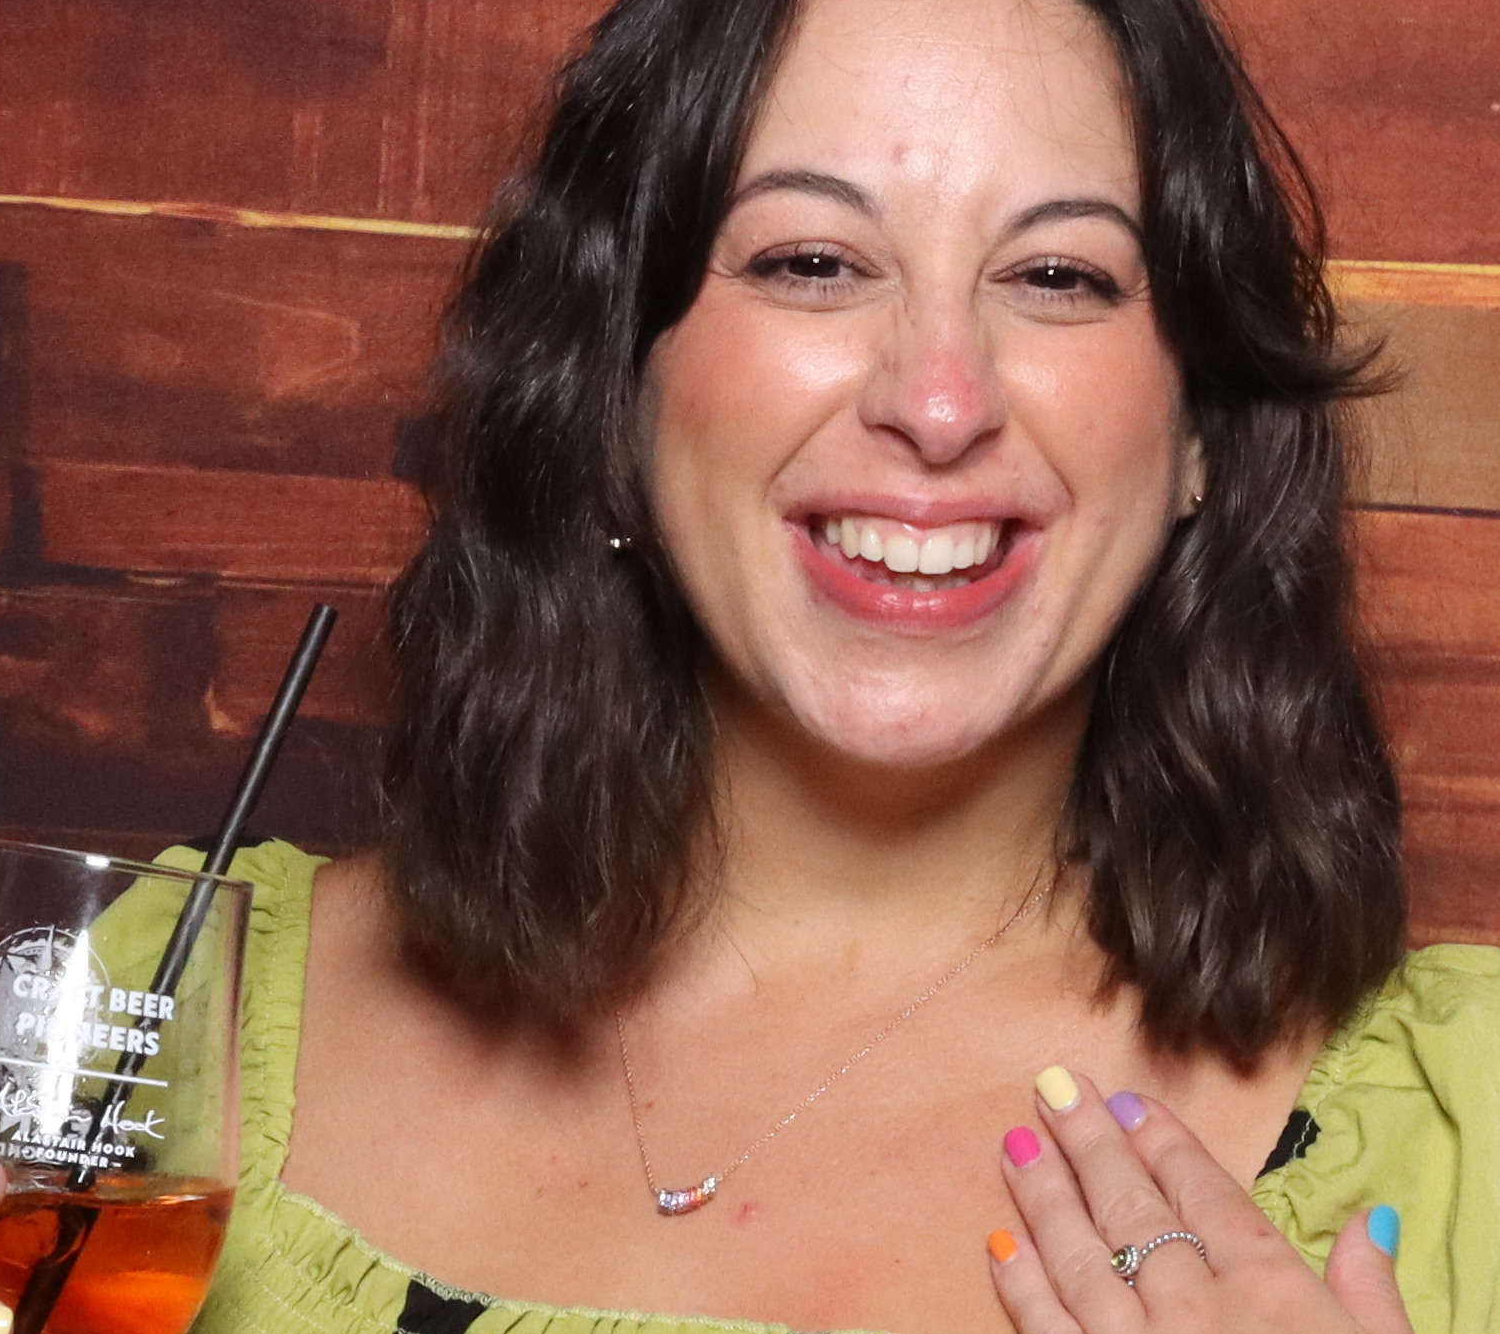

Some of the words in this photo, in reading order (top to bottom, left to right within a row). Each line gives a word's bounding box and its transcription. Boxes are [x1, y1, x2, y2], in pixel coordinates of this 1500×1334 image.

[12, 973, 105, 1009] CRT
[109, 987, 175, 1020] BEER
[10, 1129, 86, 1152] ALASTAIR
[91, 1141, 136, 1158] HOOK
[35, 1147, 110, 1169] FOUNDER
